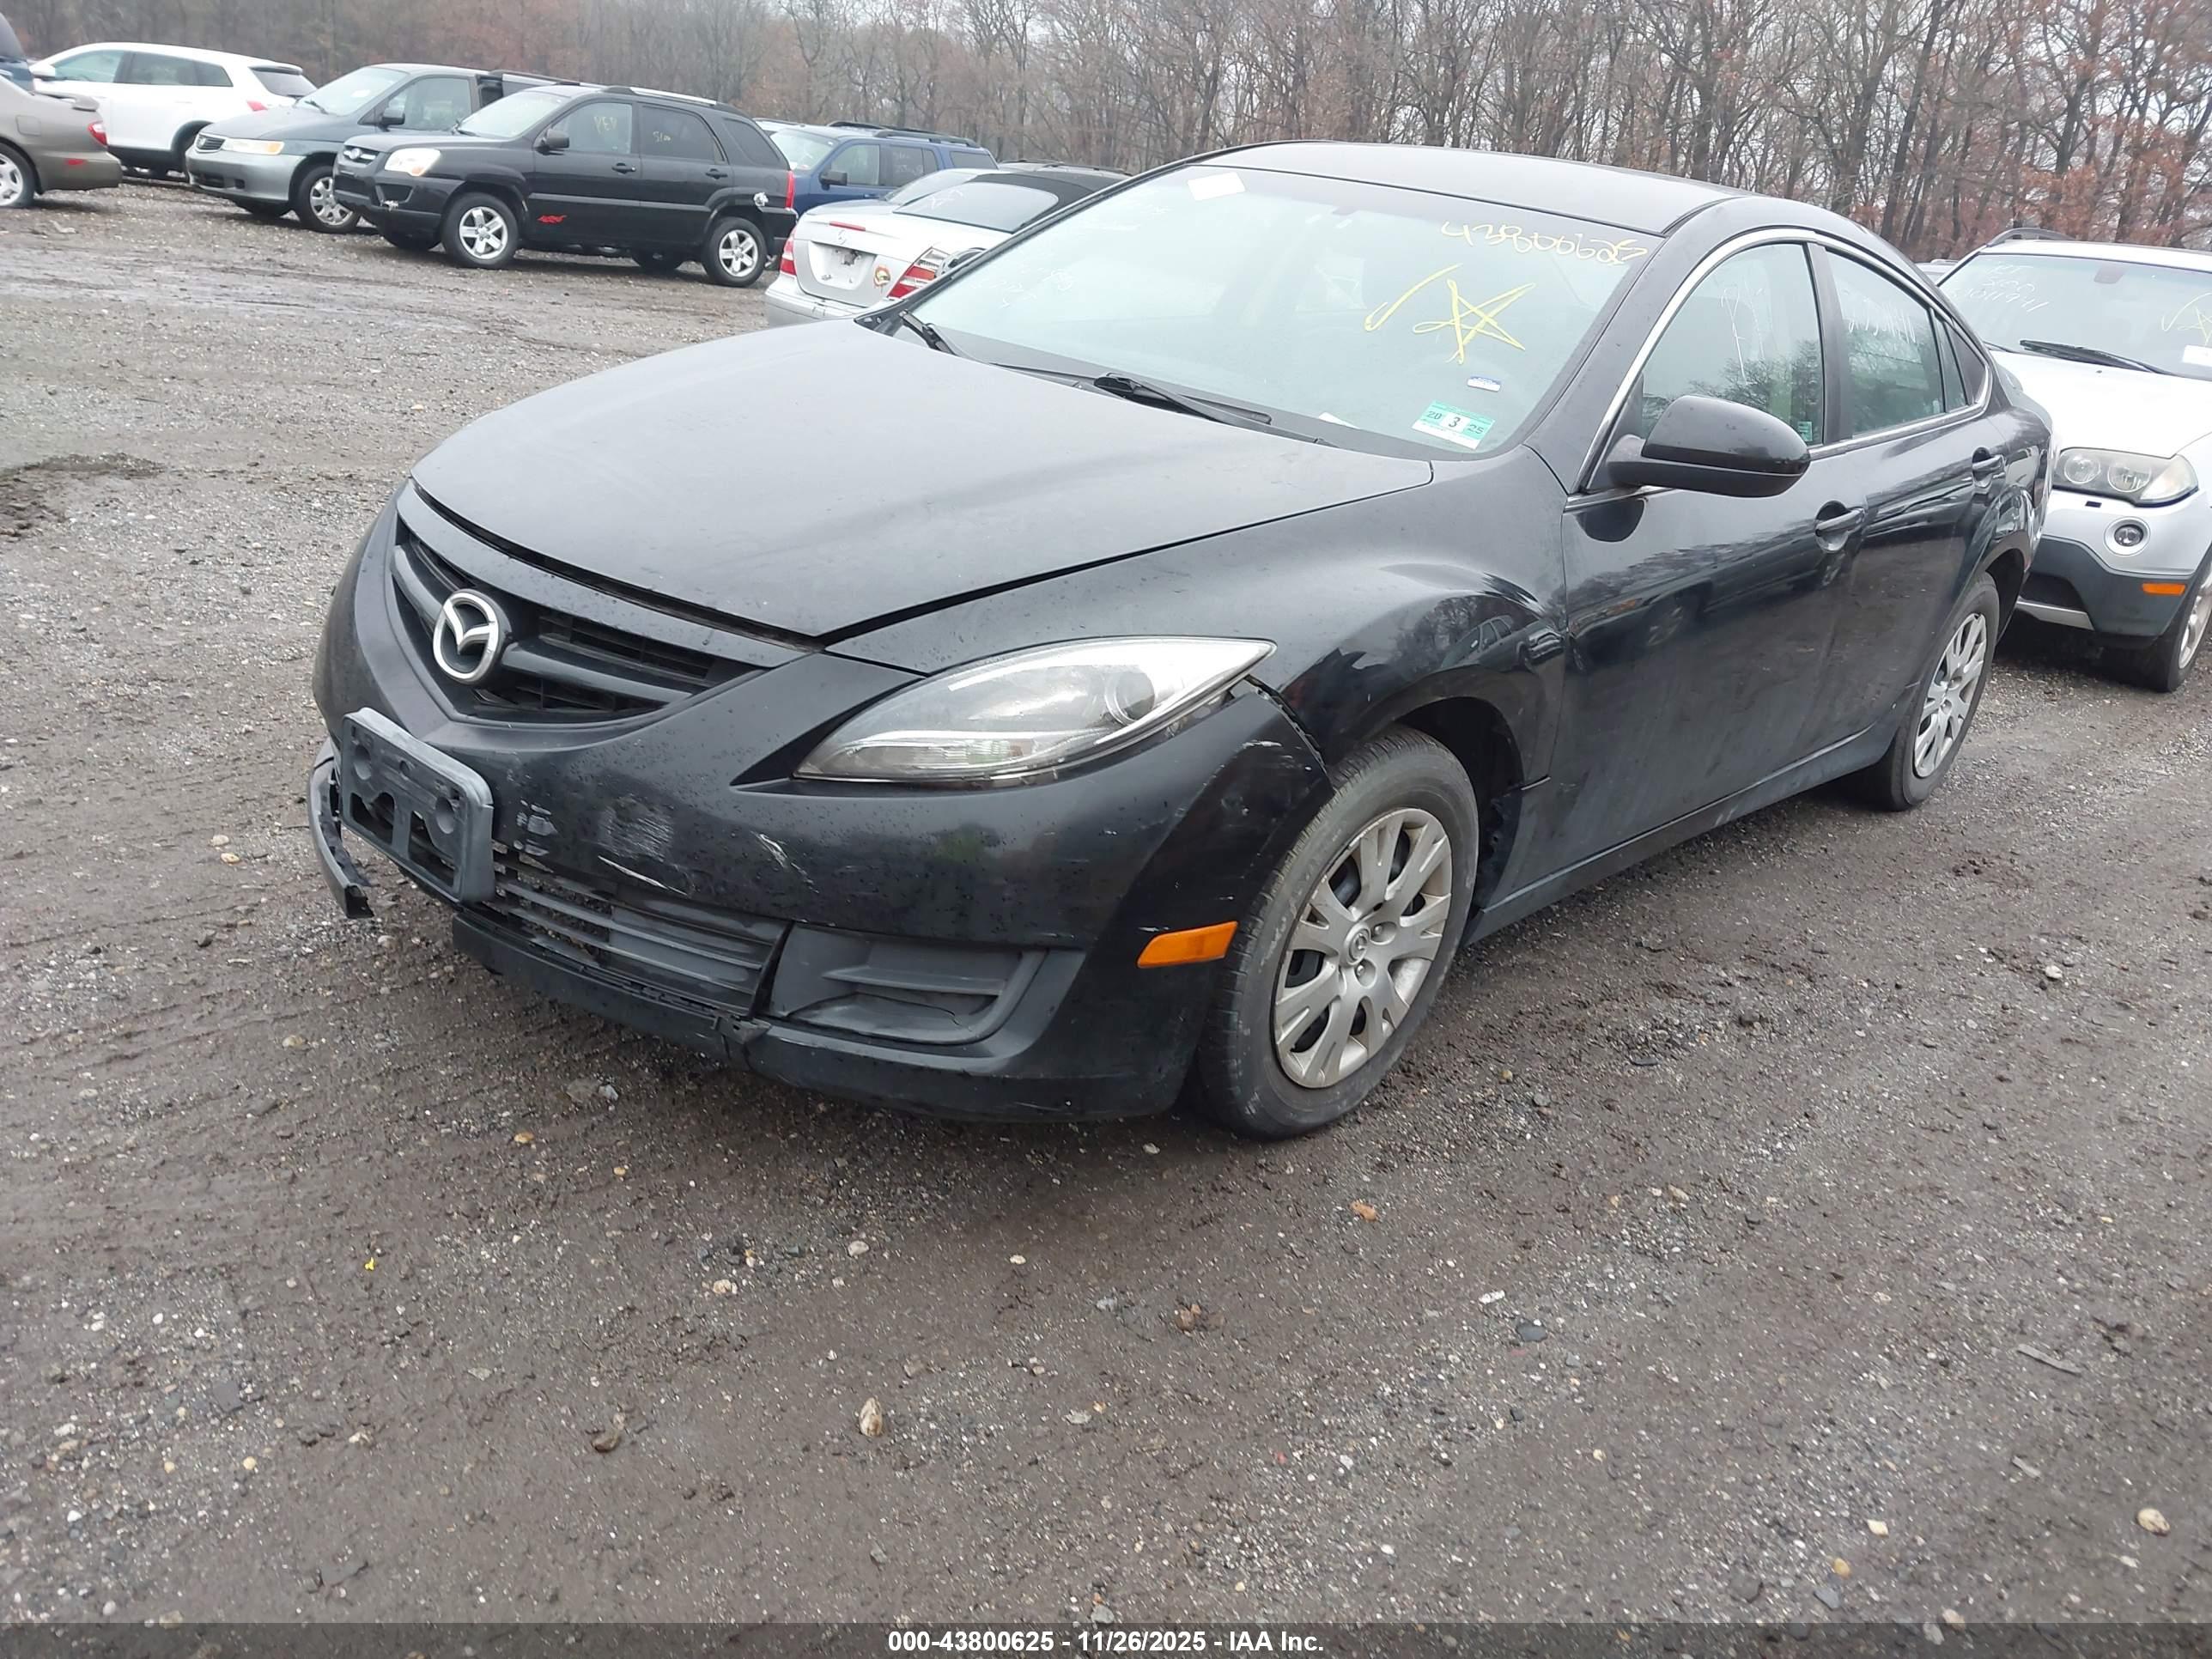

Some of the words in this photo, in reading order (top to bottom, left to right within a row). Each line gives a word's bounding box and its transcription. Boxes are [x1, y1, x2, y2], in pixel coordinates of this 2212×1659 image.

[1441, 222, 1648, 265] 43800625
[1426, 410, 1443, 420] 20
[1448, 416, 1462, 428] 3
[1467, 424, 1485, 434] 25
